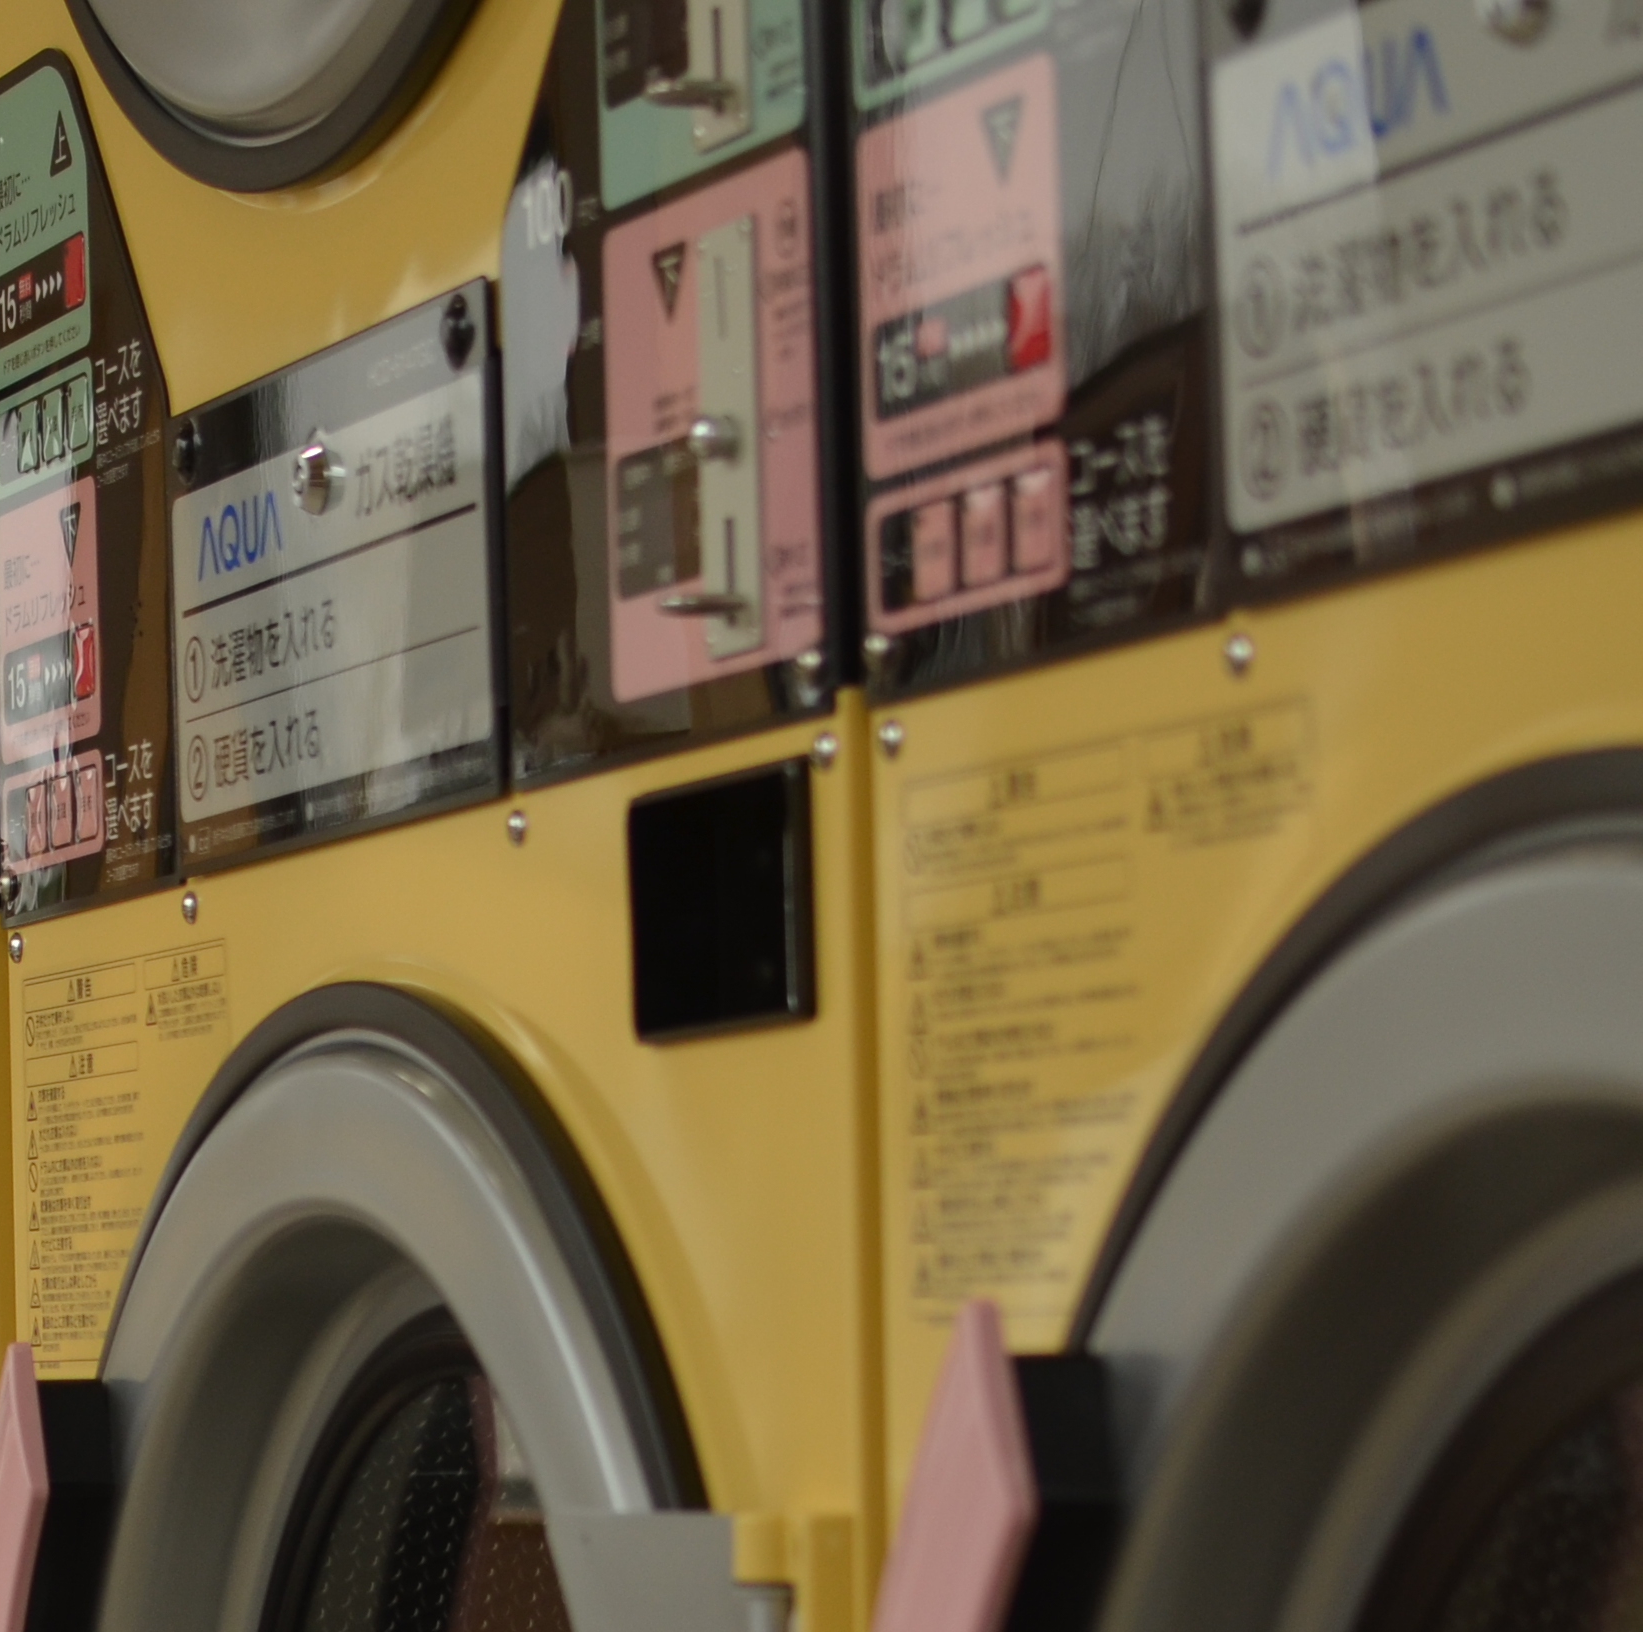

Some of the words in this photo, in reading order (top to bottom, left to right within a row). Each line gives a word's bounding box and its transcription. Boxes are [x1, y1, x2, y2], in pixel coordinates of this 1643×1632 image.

[55, 126, 67, 164] 上
[522, 170, 573, 248] 100
[95, 338, 142, 394] コースを
[95, 387, 143, 447] 選べます
[198, 490, 282, 582] AQUA
[7, 662, 25, 710] 15
[105, 738, 153, 789] コースを
[105, 788, 155, 841] 選べます
